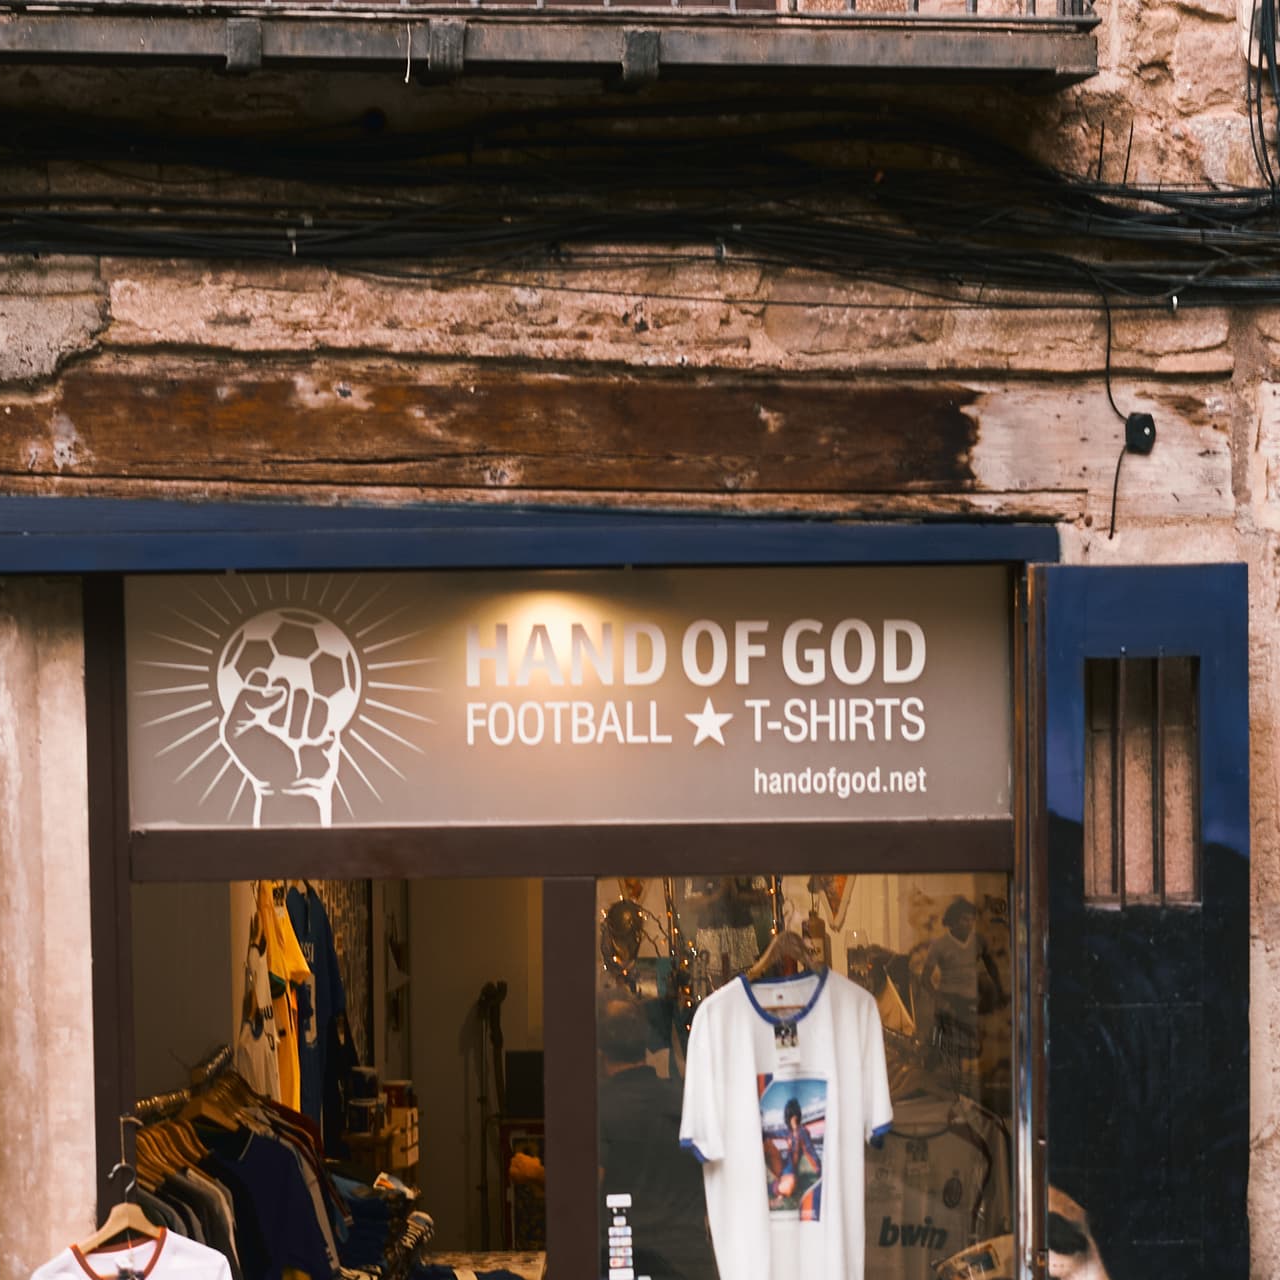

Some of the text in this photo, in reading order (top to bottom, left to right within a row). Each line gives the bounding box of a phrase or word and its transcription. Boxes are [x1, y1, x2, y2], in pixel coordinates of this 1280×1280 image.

[465, 618, 927, 688] HAND OF GOD
[466, 697, 926, 746] FOOTBALL T-SHIRTS
[753, 766, 928, 798] handofgod.net
[878, 1215, 948, 1250] bwin
